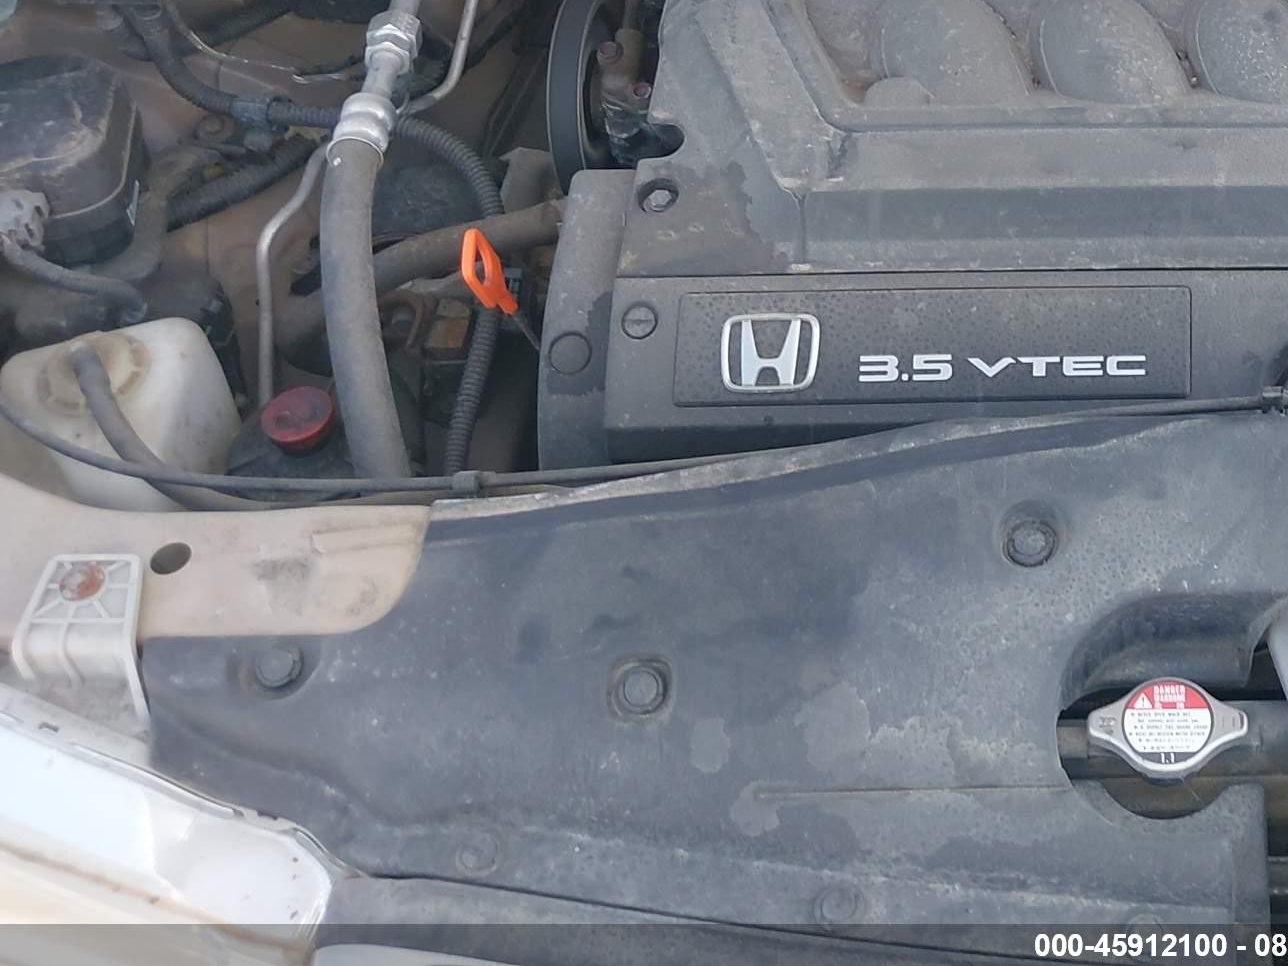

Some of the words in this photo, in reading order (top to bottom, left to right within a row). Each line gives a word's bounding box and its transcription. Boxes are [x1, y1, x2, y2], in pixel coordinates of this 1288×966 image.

[859, 354, 952, 381] 3.5
[968, 355, 1146, 377] VTEC
[1160, 752, 1175, 764] 1.1
